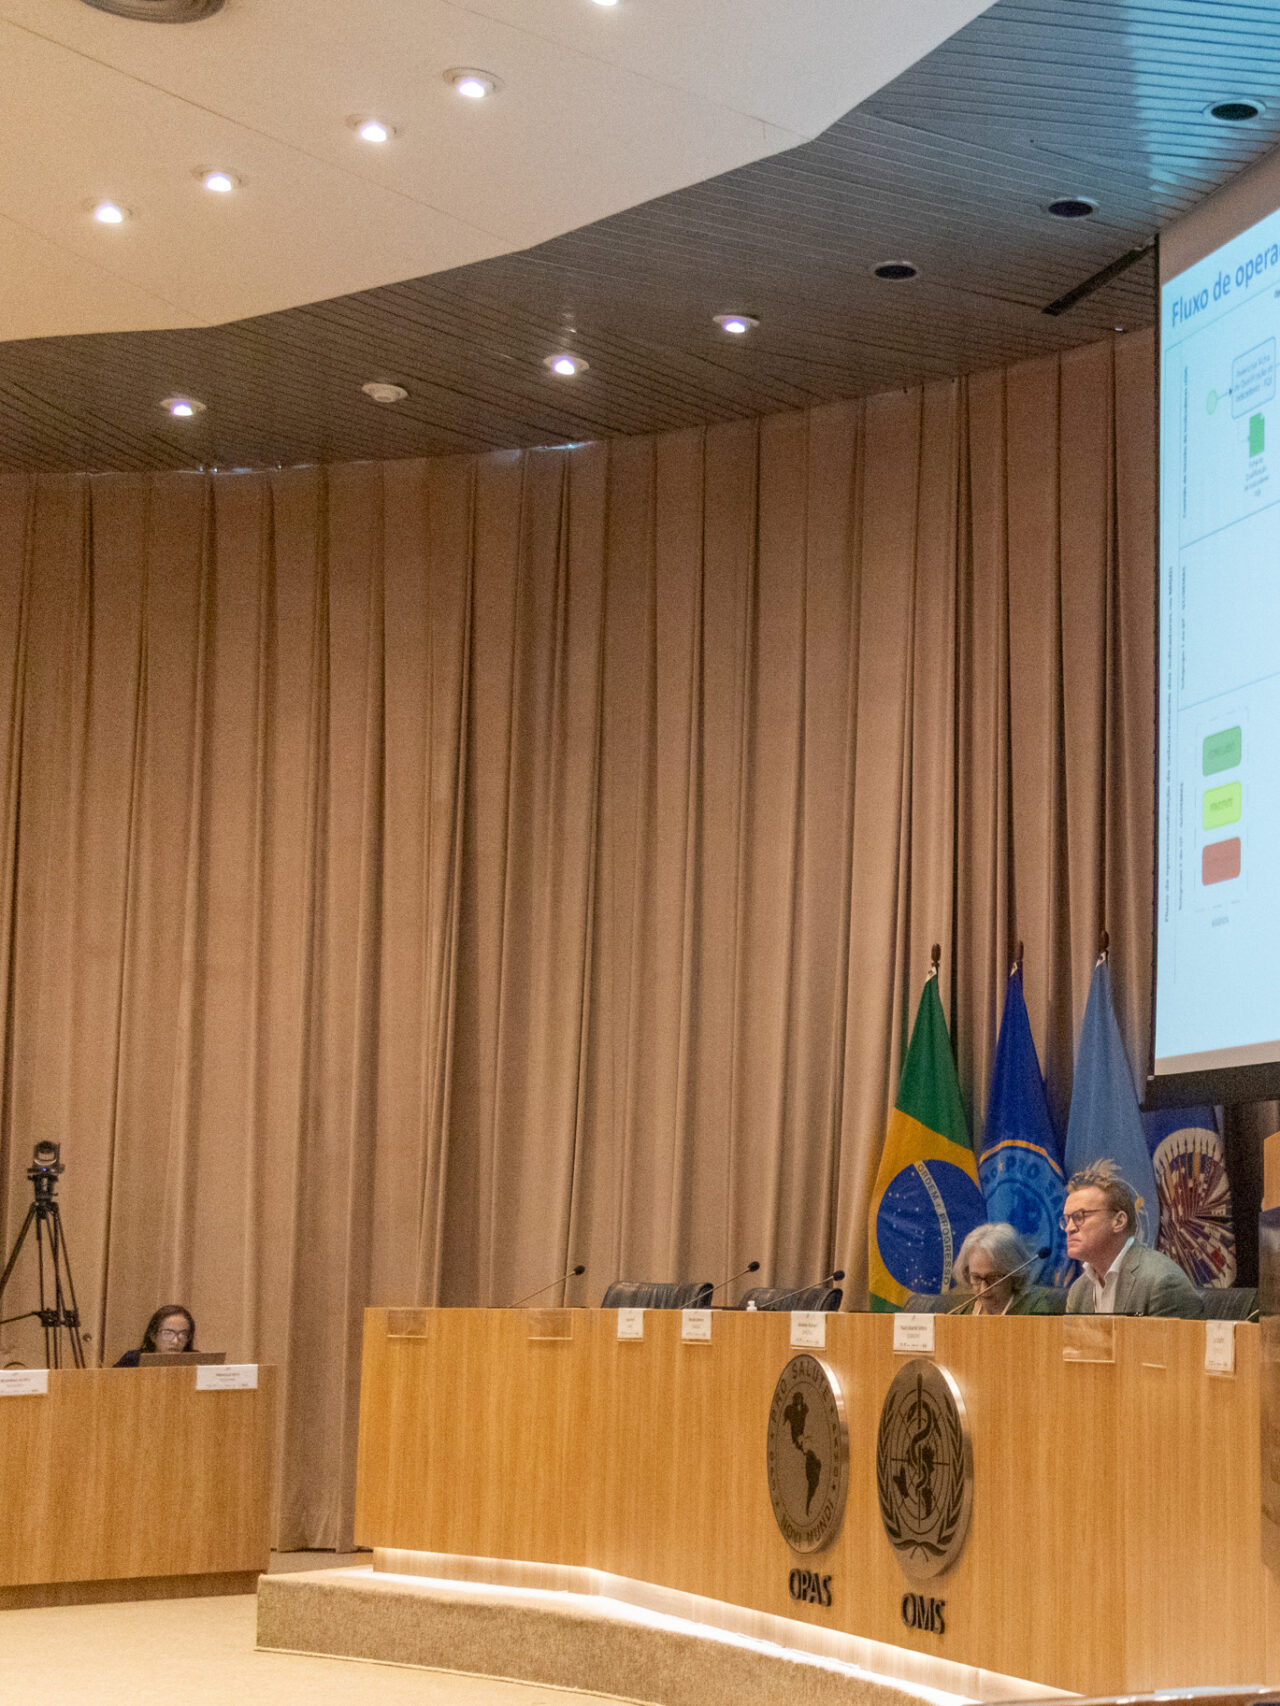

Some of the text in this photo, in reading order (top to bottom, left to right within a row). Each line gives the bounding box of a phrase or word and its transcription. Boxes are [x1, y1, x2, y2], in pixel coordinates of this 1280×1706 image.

[1172, 289, 1208, 327] Fluxo
[1213, 272, 1230, 301] de
[918, 1163, 939, 1204] ORDEM
[939, 1213, 952, 1285] PROGRESSO
[791, 1362, 832, 1402] SALUTE
[789, 1569, 832, 1606] OPAS
[902, 1593, 946, 1634] OMS
